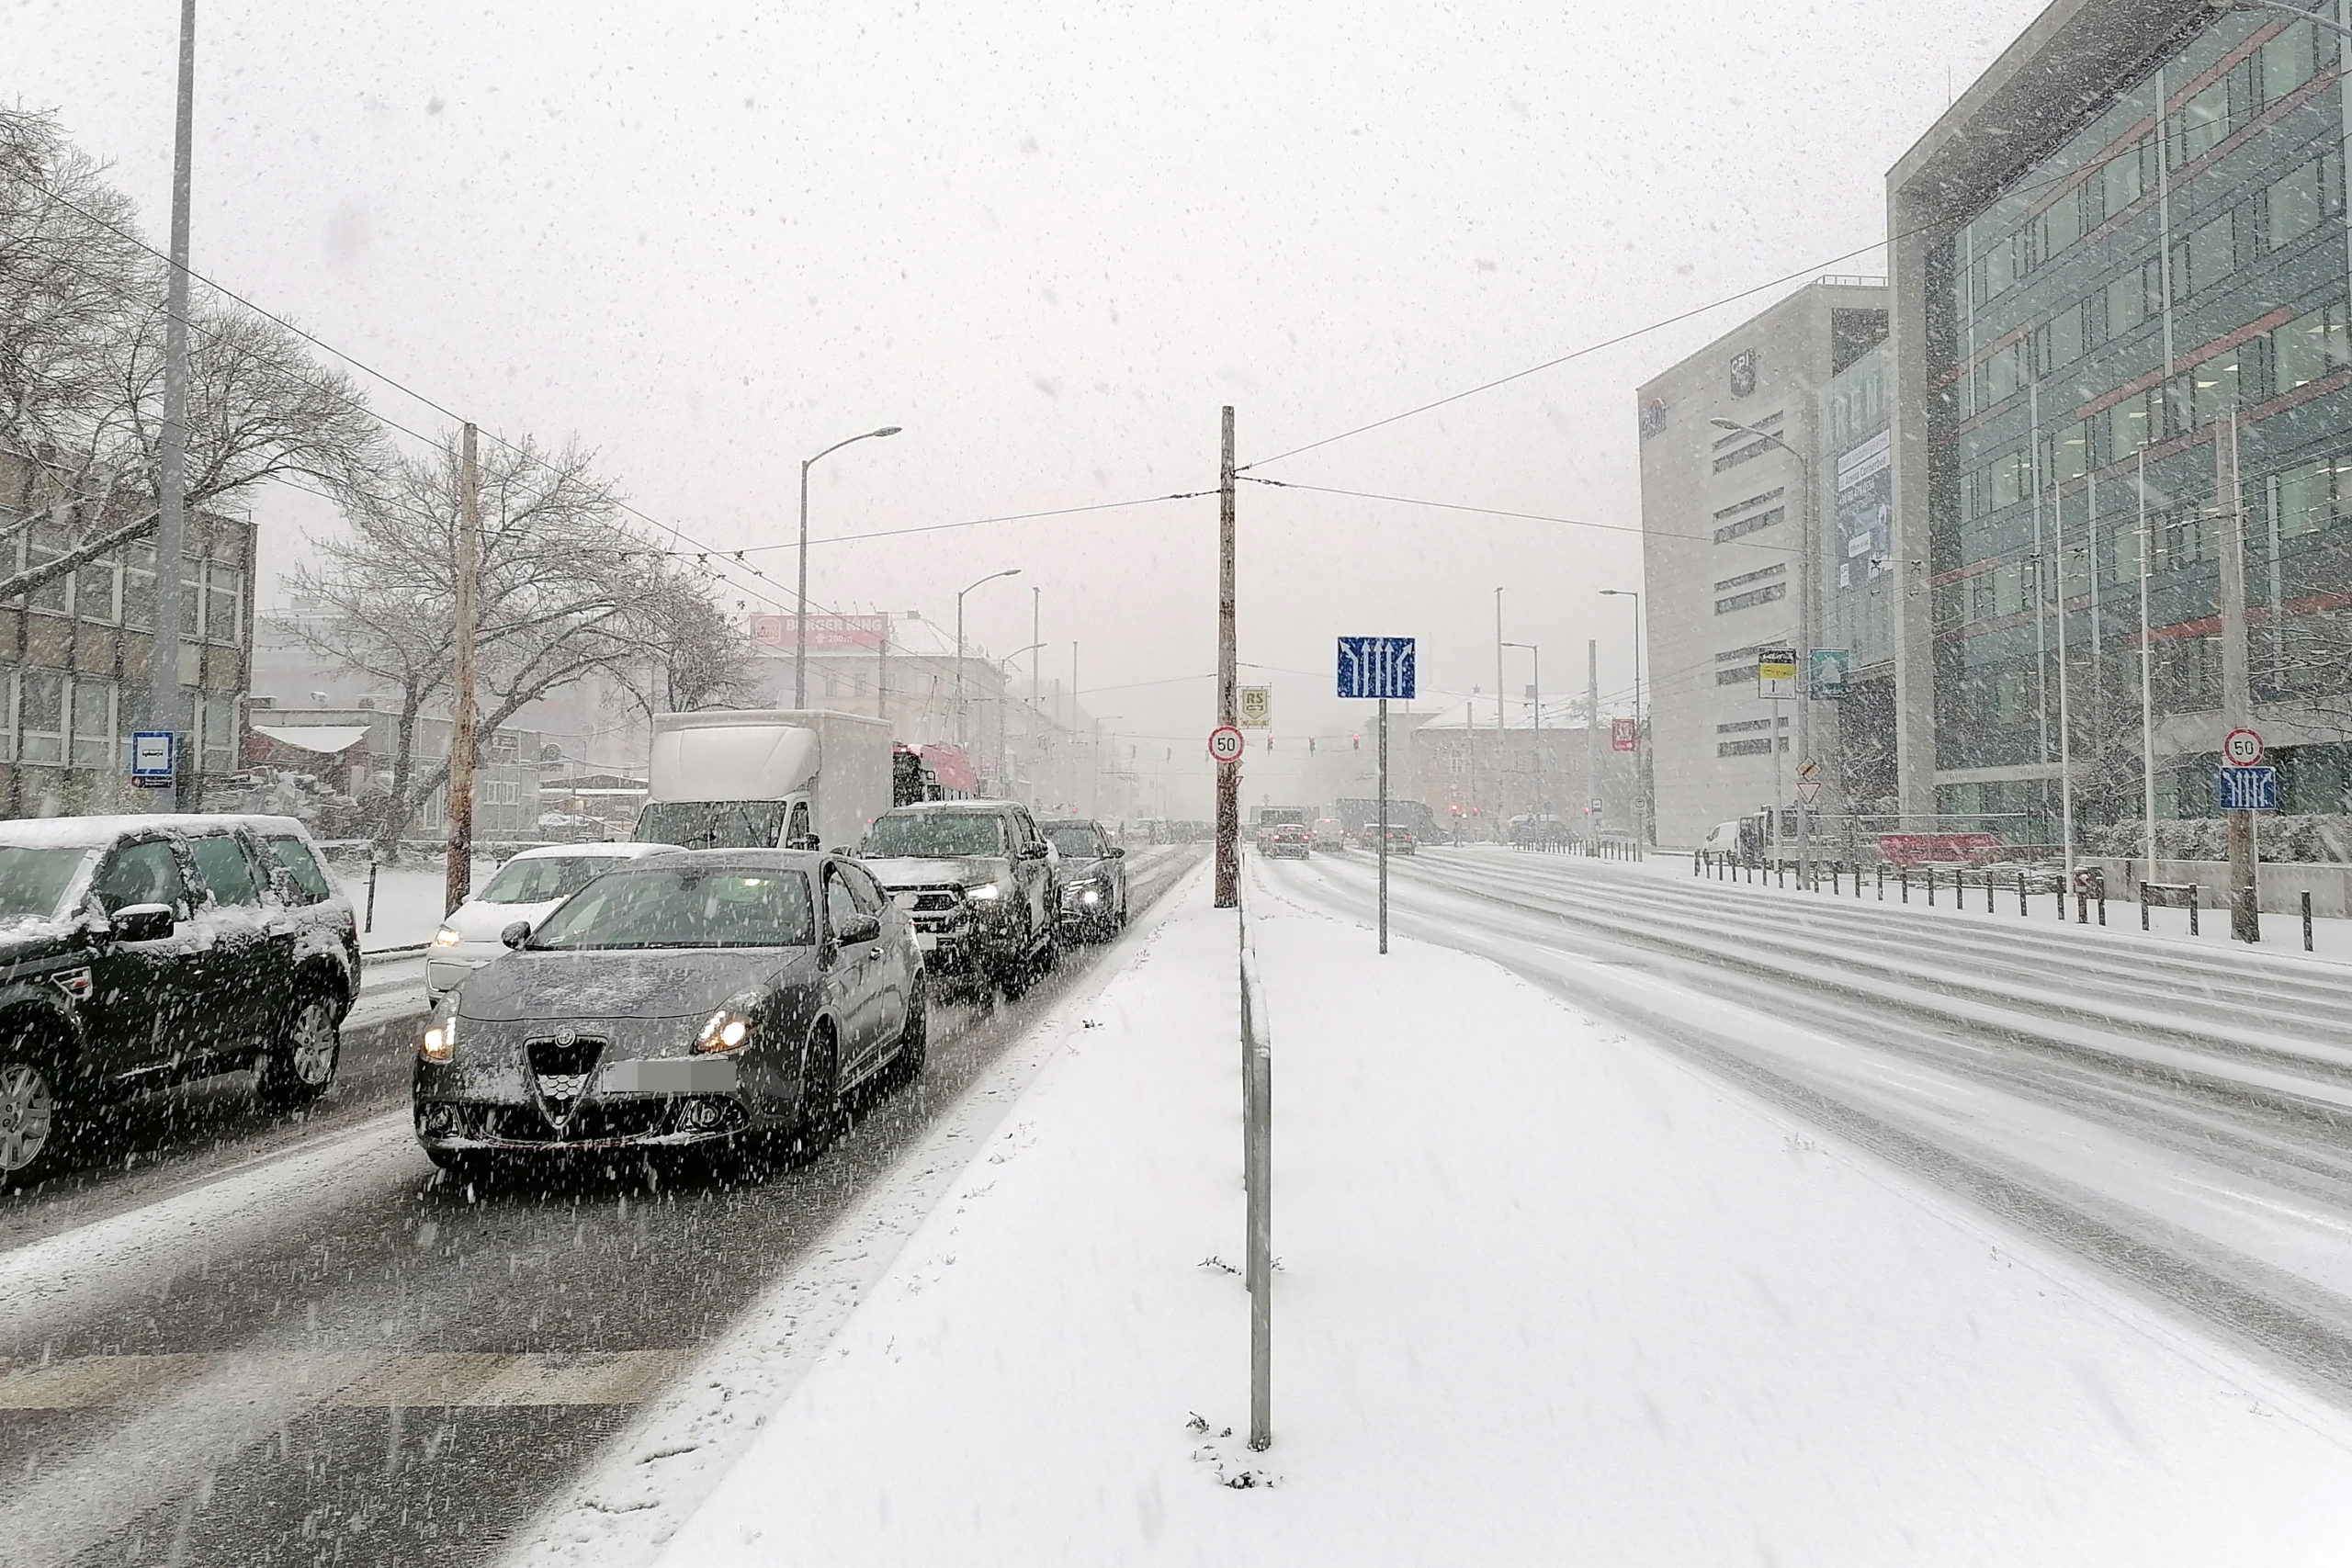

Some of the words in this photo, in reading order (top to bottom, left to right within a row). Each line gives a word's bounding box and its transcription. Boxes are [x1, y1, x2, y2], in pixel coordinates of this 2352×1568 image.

[1731, 350, 1750, 374] CPI
[786, 618, 842, 631] BRGER
[846, 618, 882, 632] KING
[1246, 693, 1263, 704] RS
[1217, 737, 1236, 751] 50
[2233, 740, 2254, 756] 50
